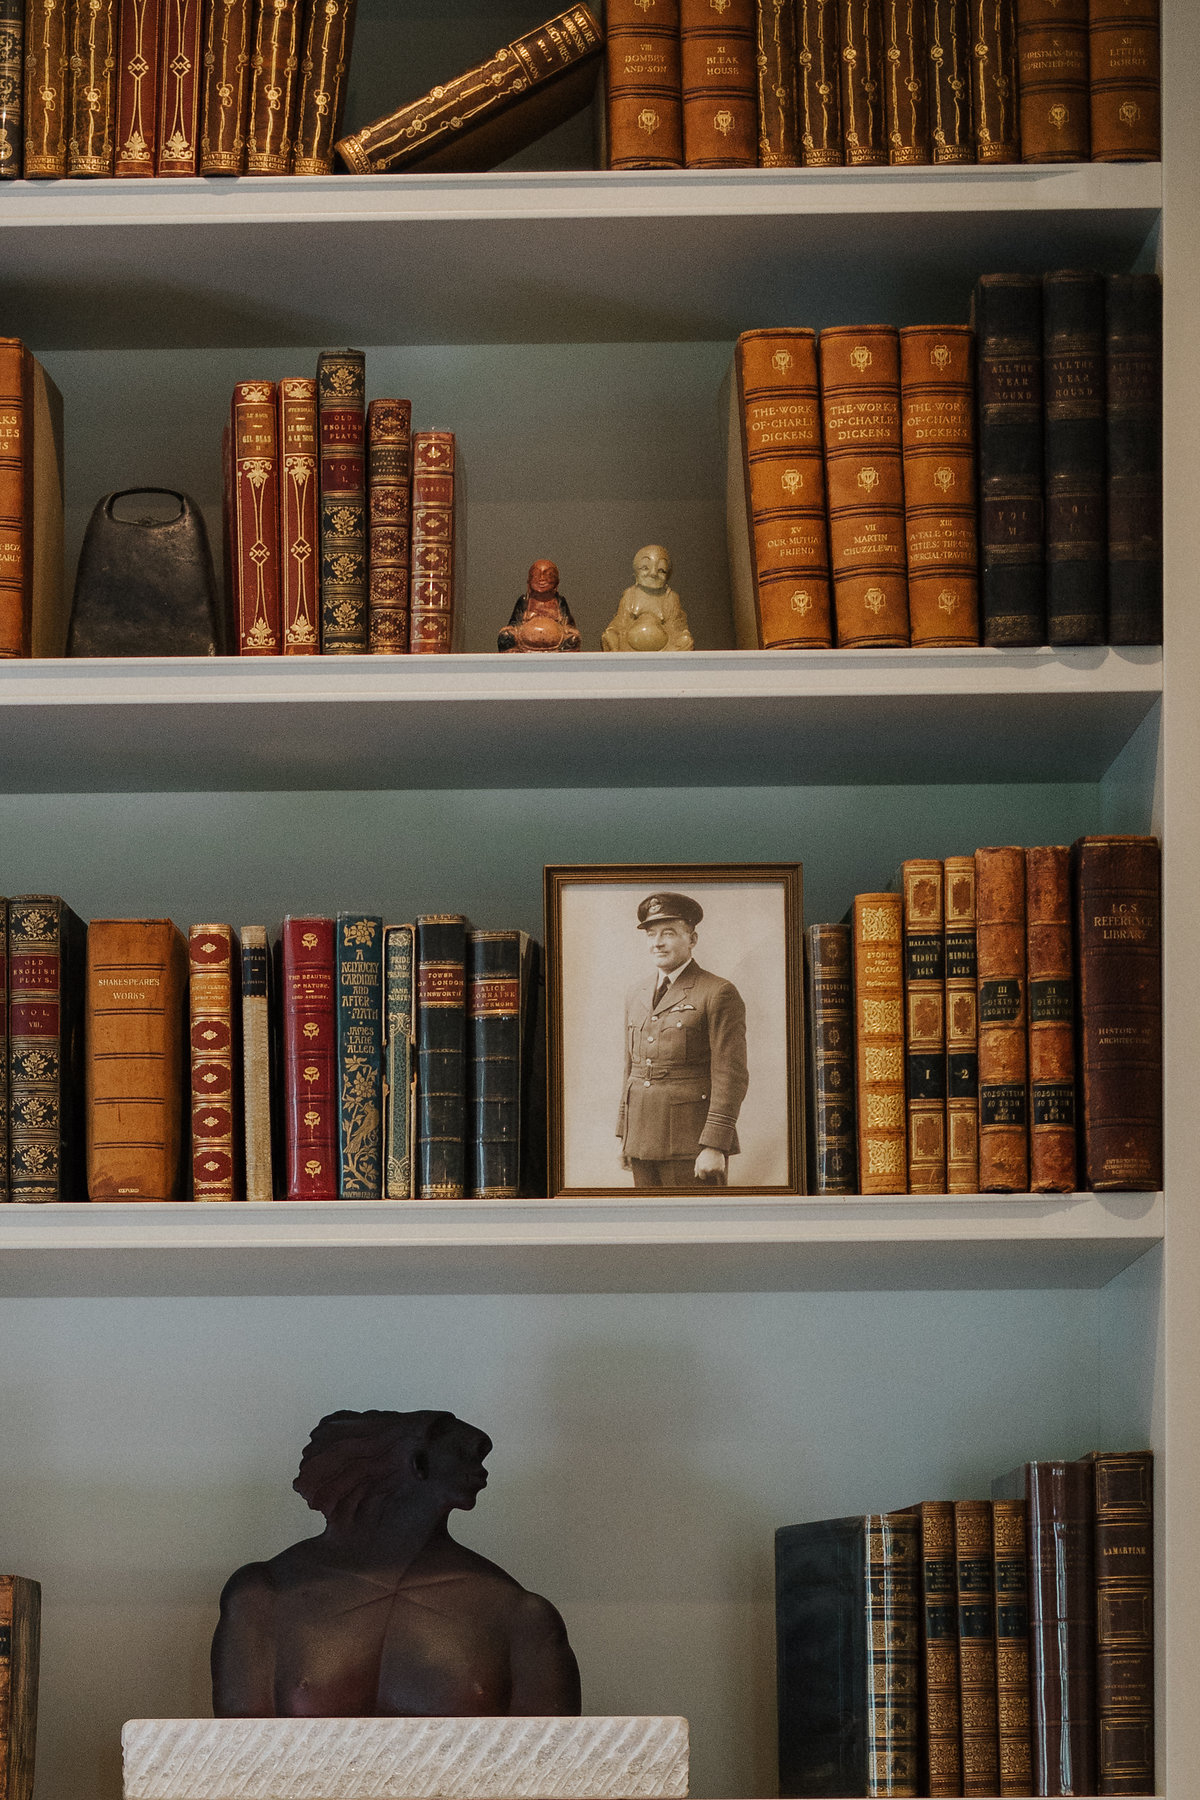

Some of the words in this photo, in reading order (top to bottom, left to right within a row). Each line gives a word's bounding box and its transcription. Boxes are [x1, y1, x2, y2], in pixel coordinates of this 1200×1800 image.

[572, 11, 596, 43] NATURE
[545, 24, 571, 62] LECTURES
[516, 42, 539, 79] EMERSON
[706, 56, 740, 65] BLEAK
[707, 67, 740, 75] HOUSE
[761, 431, 813, 442] DICKENS
[838, 429, 890, 440] DICKENS
[916, 428, 968, 438] DICKENS
[791, 526, 802, 534] XV
[854, 534, 888, 543] MARTIN
[779, 547, 814, 556] FRIEND
[843, 545, 898, 556] CHUZZLEWIT
[1093, 917, 1154, 927] REFERENCE
[1103, 930, 1147, 940] LIBRARY
[356, 949, 365, 961] A
[912, 954, 939, 962] MIDDLE
[13, 967, 56, 975] ENGLISH
[341, 961, 380, 973] KENTUCKY
[917, 968, 934, 976] AGES
[952, 966, 970, 974] AGES
[98, 978, 160, 986] SHAKESPEARE'S
[341, 973, 379, 986] CARDINAL
[353, 986, 369, 995] AND
[112, 992, 145, 1000] WORKS
[346, 1026, 374, 1036] JAMES
[1098, 1027, 1137, 1035] HISTORY
[349, 1035, 372, 1045] LANE
[346, 1044, 375, 1054] ALLEN
[961, 1069, 969, 1079] 2
[1103, 1547, 1146, 1556] LAMARTINE
